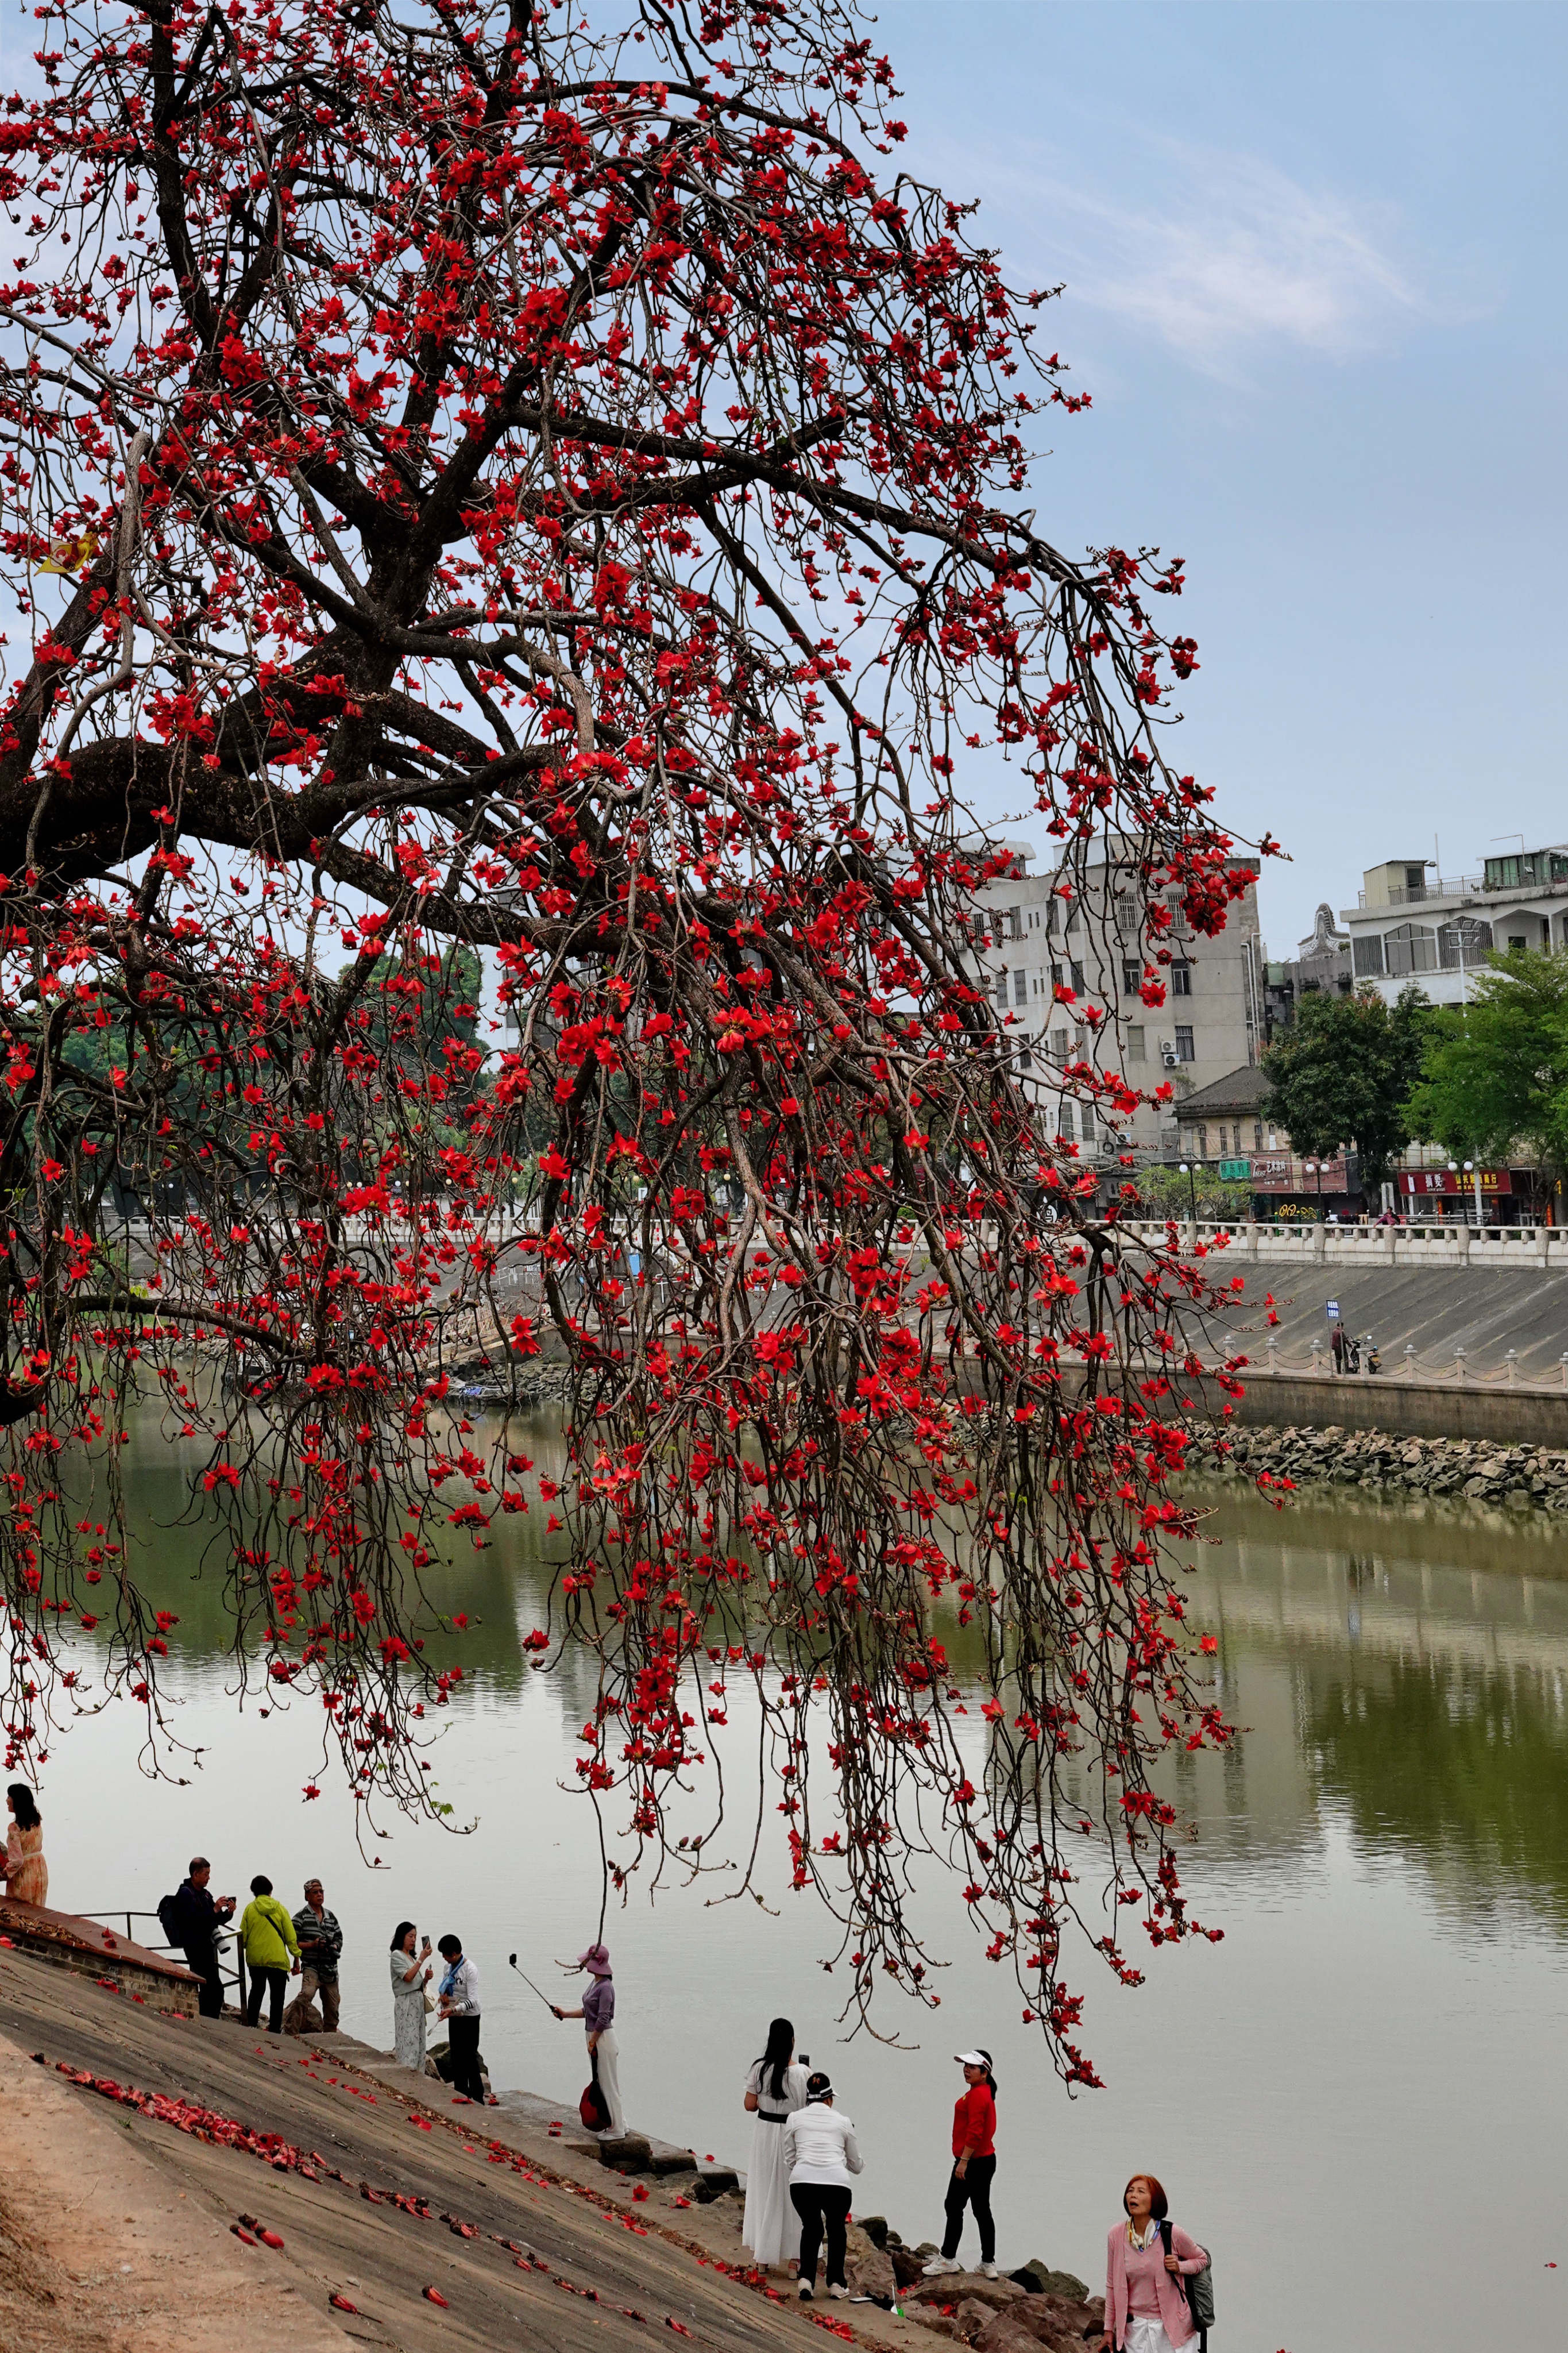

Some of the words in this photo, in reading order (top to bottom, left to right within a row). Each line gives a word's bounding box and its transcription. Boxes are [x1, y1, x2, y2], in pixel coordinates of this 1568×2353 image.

[1266, 1160, 1286, 1173] 艺术涂料
[1425, 1173, 1443, 1187] 摘要
